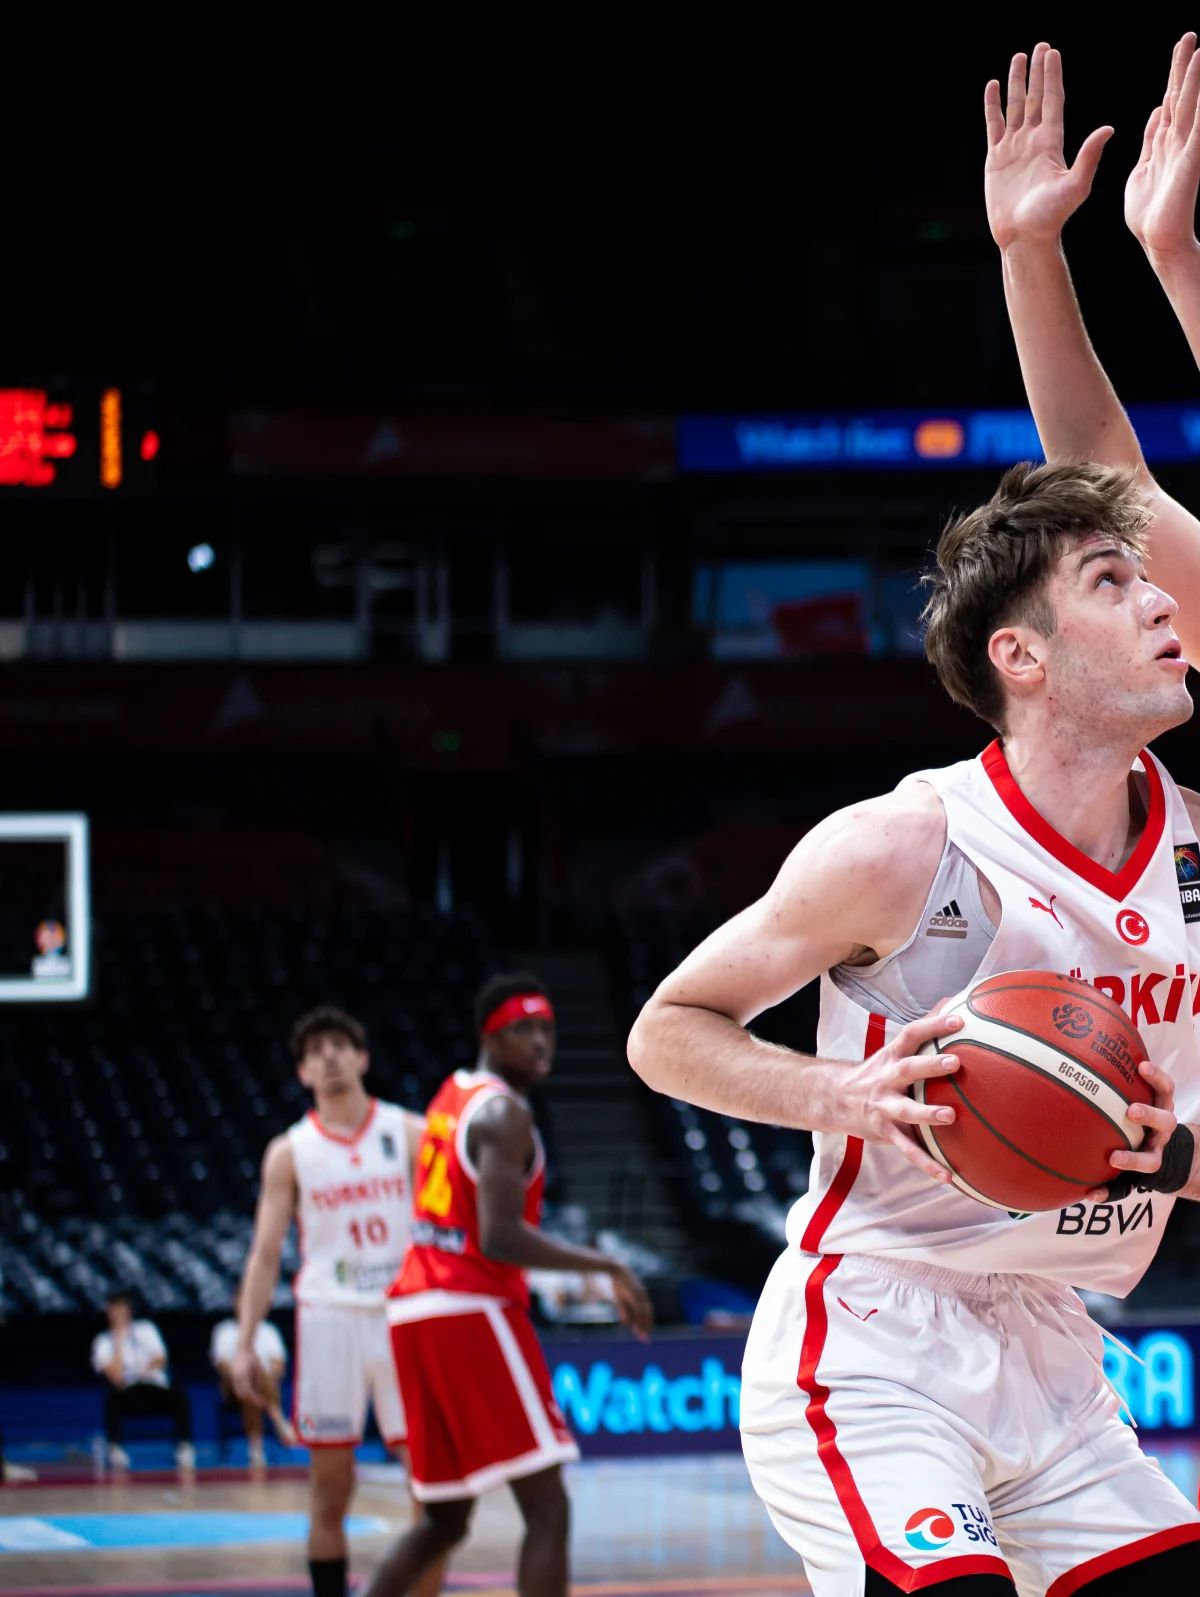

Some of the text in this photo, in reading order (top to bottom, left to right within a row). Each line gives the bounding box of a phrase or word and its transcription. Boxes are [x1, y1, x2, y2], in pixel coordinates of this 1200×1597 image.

[1180, 888, 1200, 904] IBA
[930, 916, 969, 928] adidas
[1058, 1061, 1100, 1096] BG4500
[348, 1214, 389, 1249] 10
[1056, 1198, 1153, 1236] BBVA
[553, 1356, 741, 1434] Watch
